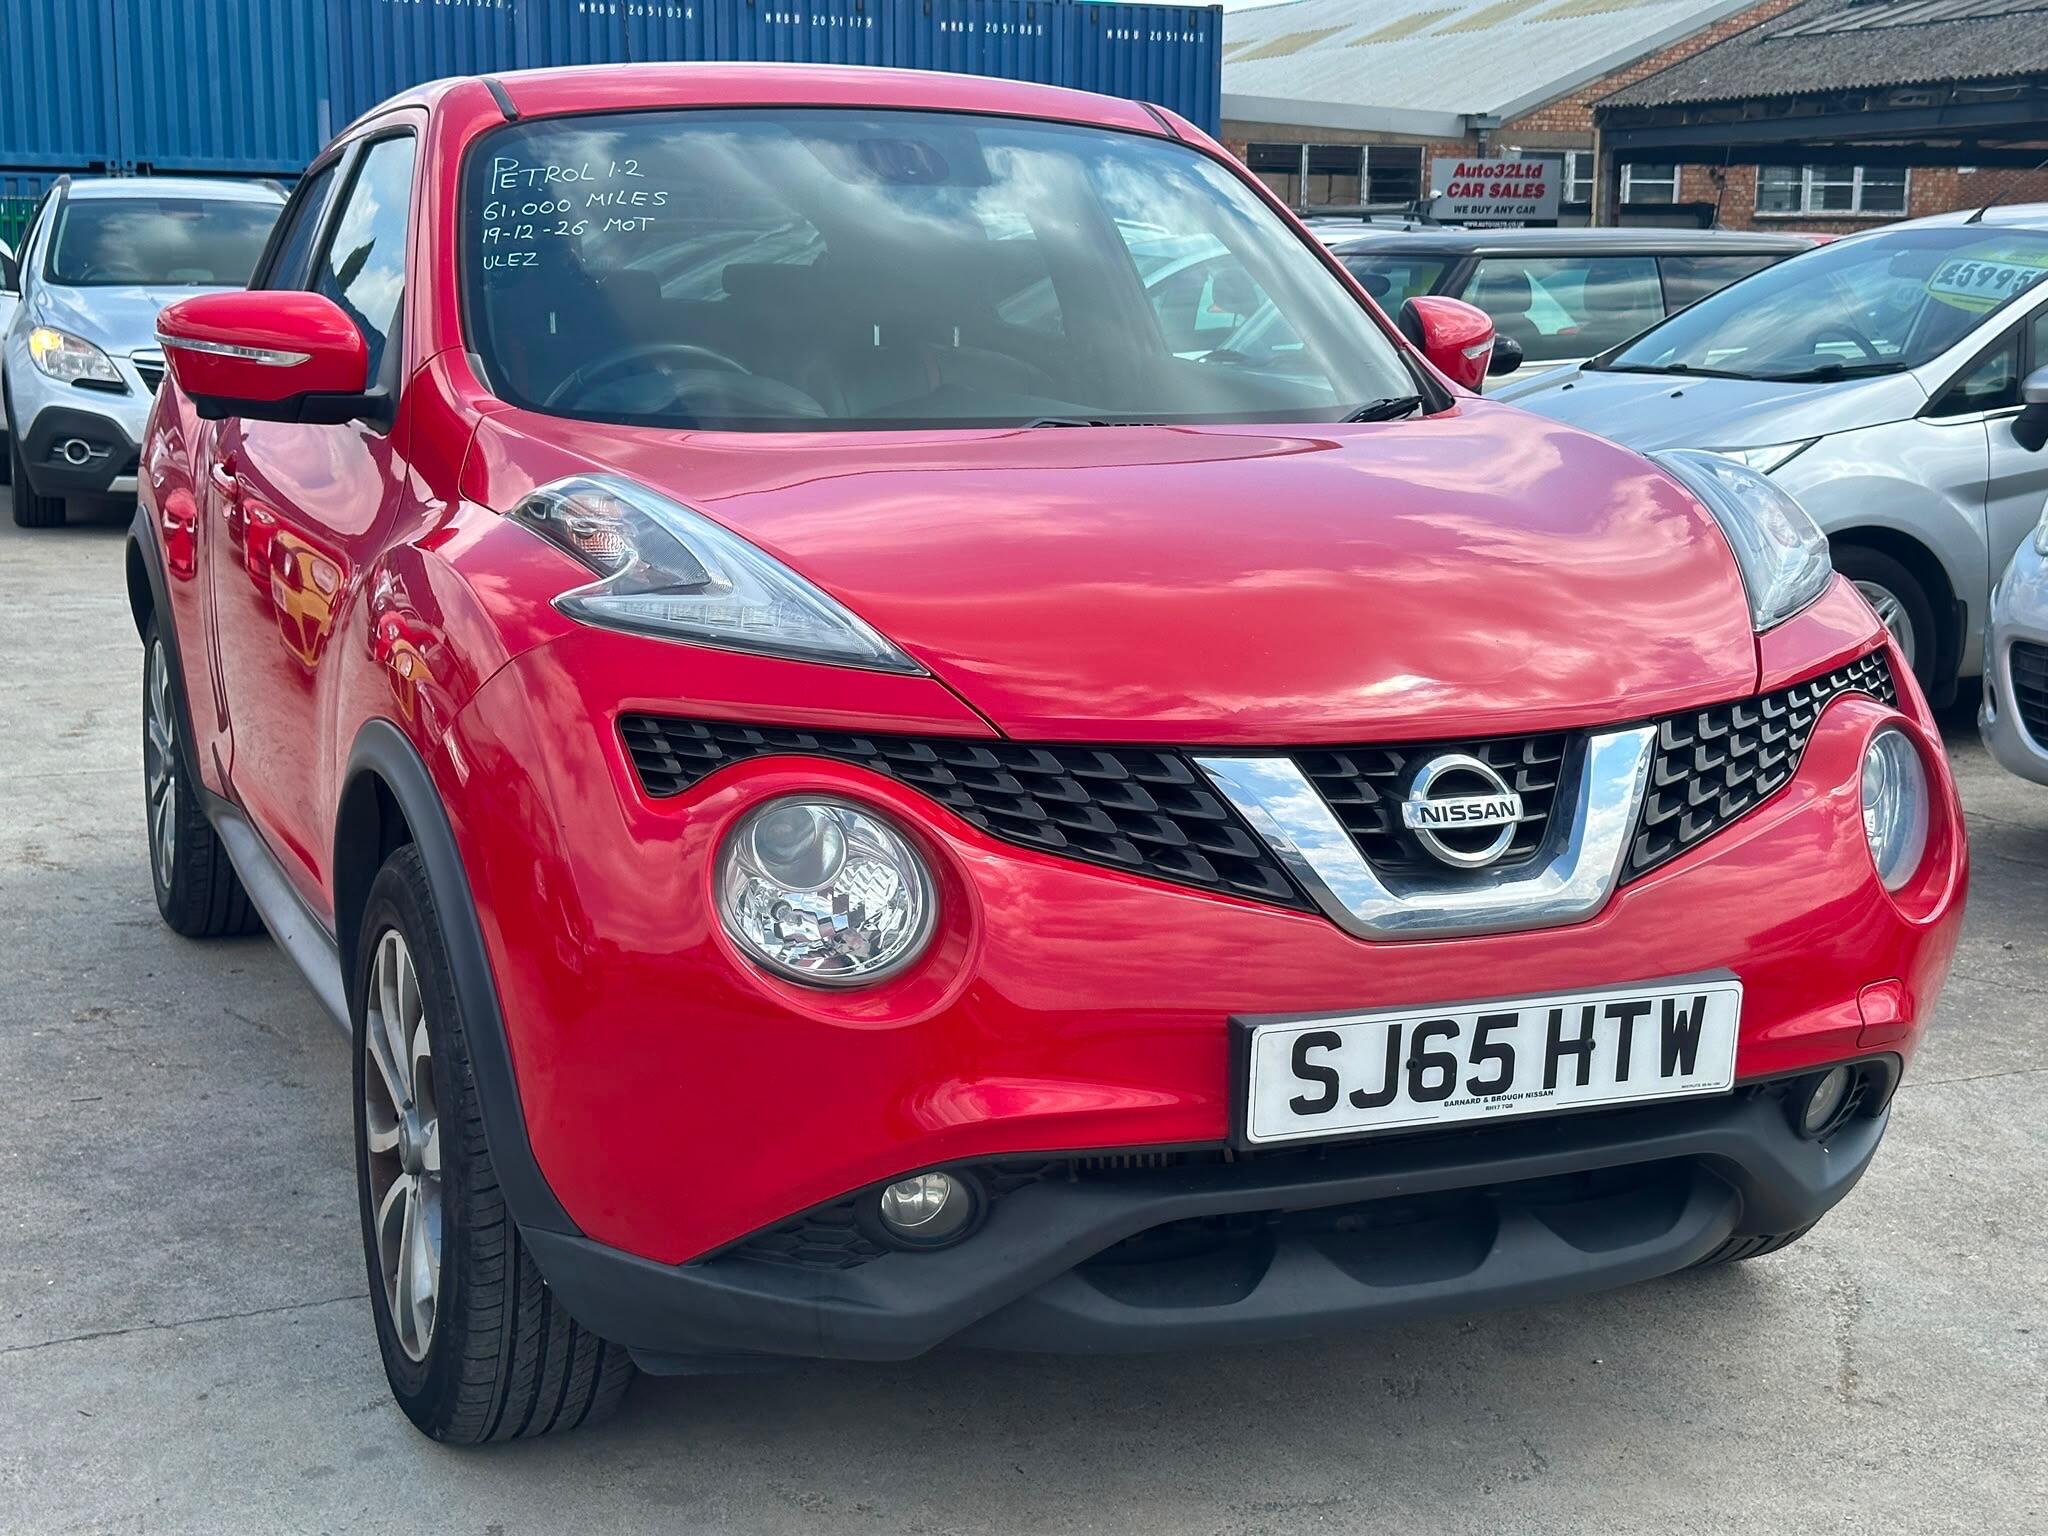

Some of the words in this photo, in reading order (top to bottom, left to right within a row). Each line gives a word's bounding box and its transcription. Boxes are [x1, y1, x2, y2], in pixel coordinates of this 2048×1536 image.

[579, 3, 616, 15] MRBU
[629, 4, 693, 19] 2051034
[813, 15, 872, 28] 2051179
[491, 157, 595, 195] PETROL
[608, 159, 645, 178] 1.2
[1453, 162, 1544, 179] Auto32Ltd
[585, 190, 669, 208] MILES
[1446, 182, 1485, 198] CAR
[1488, 182, 1546, 199] SALES
[1453, 205, 1470, 214] WE
[1471, 205, 1492, 215] BUY
[1493, 205, 1515, 215] ANY
[1516, 205, 1536, 215] CAR
[603, 217, 656, 232] MOT
[483, 252, 540, 270] ULEZ
[1419, 800, 1516, 823] NISSAN
[1288, 1012, 1520, 1117] SJ65
[1543, 995, 1708, 1090] HTW
[1443, 1097, 1481, 1107] BARNARD
[1491, 1093, 1524, 1103] BROUGH
[1525, 1090, 1554, 1099] NISSAN
